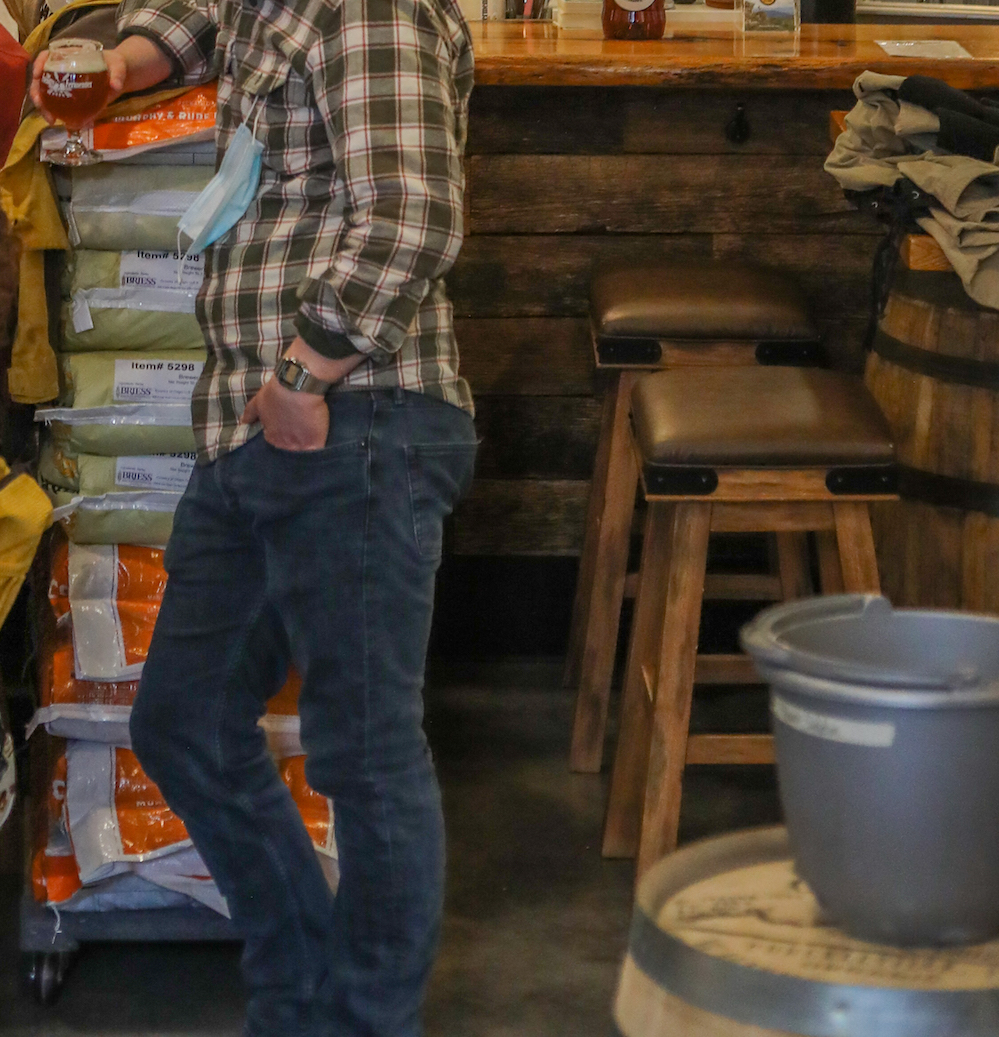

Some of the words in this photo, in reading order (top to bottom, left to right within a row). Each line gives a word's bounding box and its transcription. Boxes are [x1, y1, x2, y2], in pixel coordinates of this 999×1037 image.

[137, 249, 169, 259] Item#
[131, 362, 164, 371] Item#
[167, 363, 195, 372] 5298
[120, 387, 151, 396] BRIESS
[122, 471, 153, 481] BRIESS
